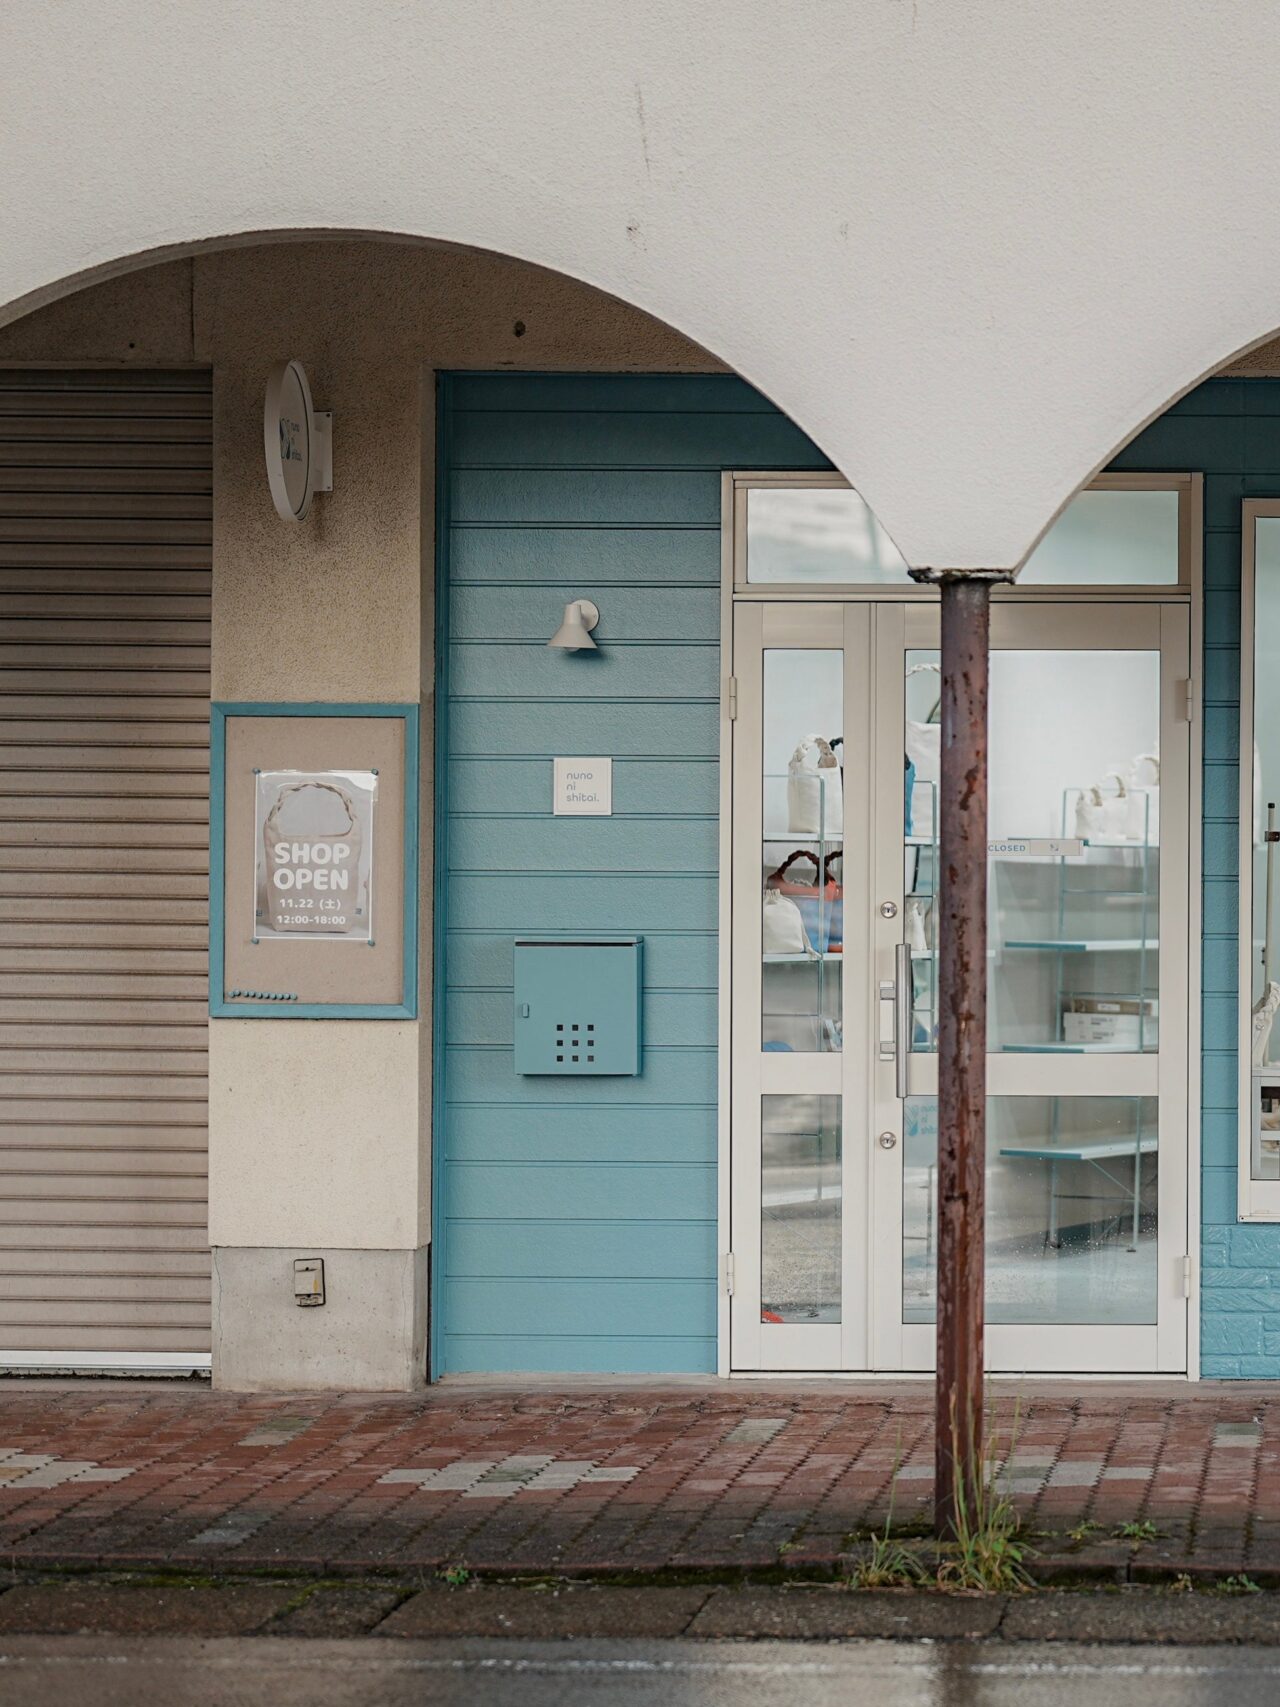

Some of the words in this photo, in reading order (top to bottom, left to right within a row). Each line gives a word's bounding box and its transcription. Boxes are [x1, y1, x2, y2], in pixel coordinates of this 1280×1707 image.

[566, 772, 593, 780] nuno
[566, 781, 576, 791] ni
[566, 793, 600, 802] shitai.
[988, 844, 1026, 852] CLOSED
[274, 842, 351, 865] SHOP
[273, 868, 348, 890] OPEN
[279, 898, 314, 908] 11.22
[319, 899, 342, 910] (土)
[276, 915, 346, 925] 12:00-18:00
